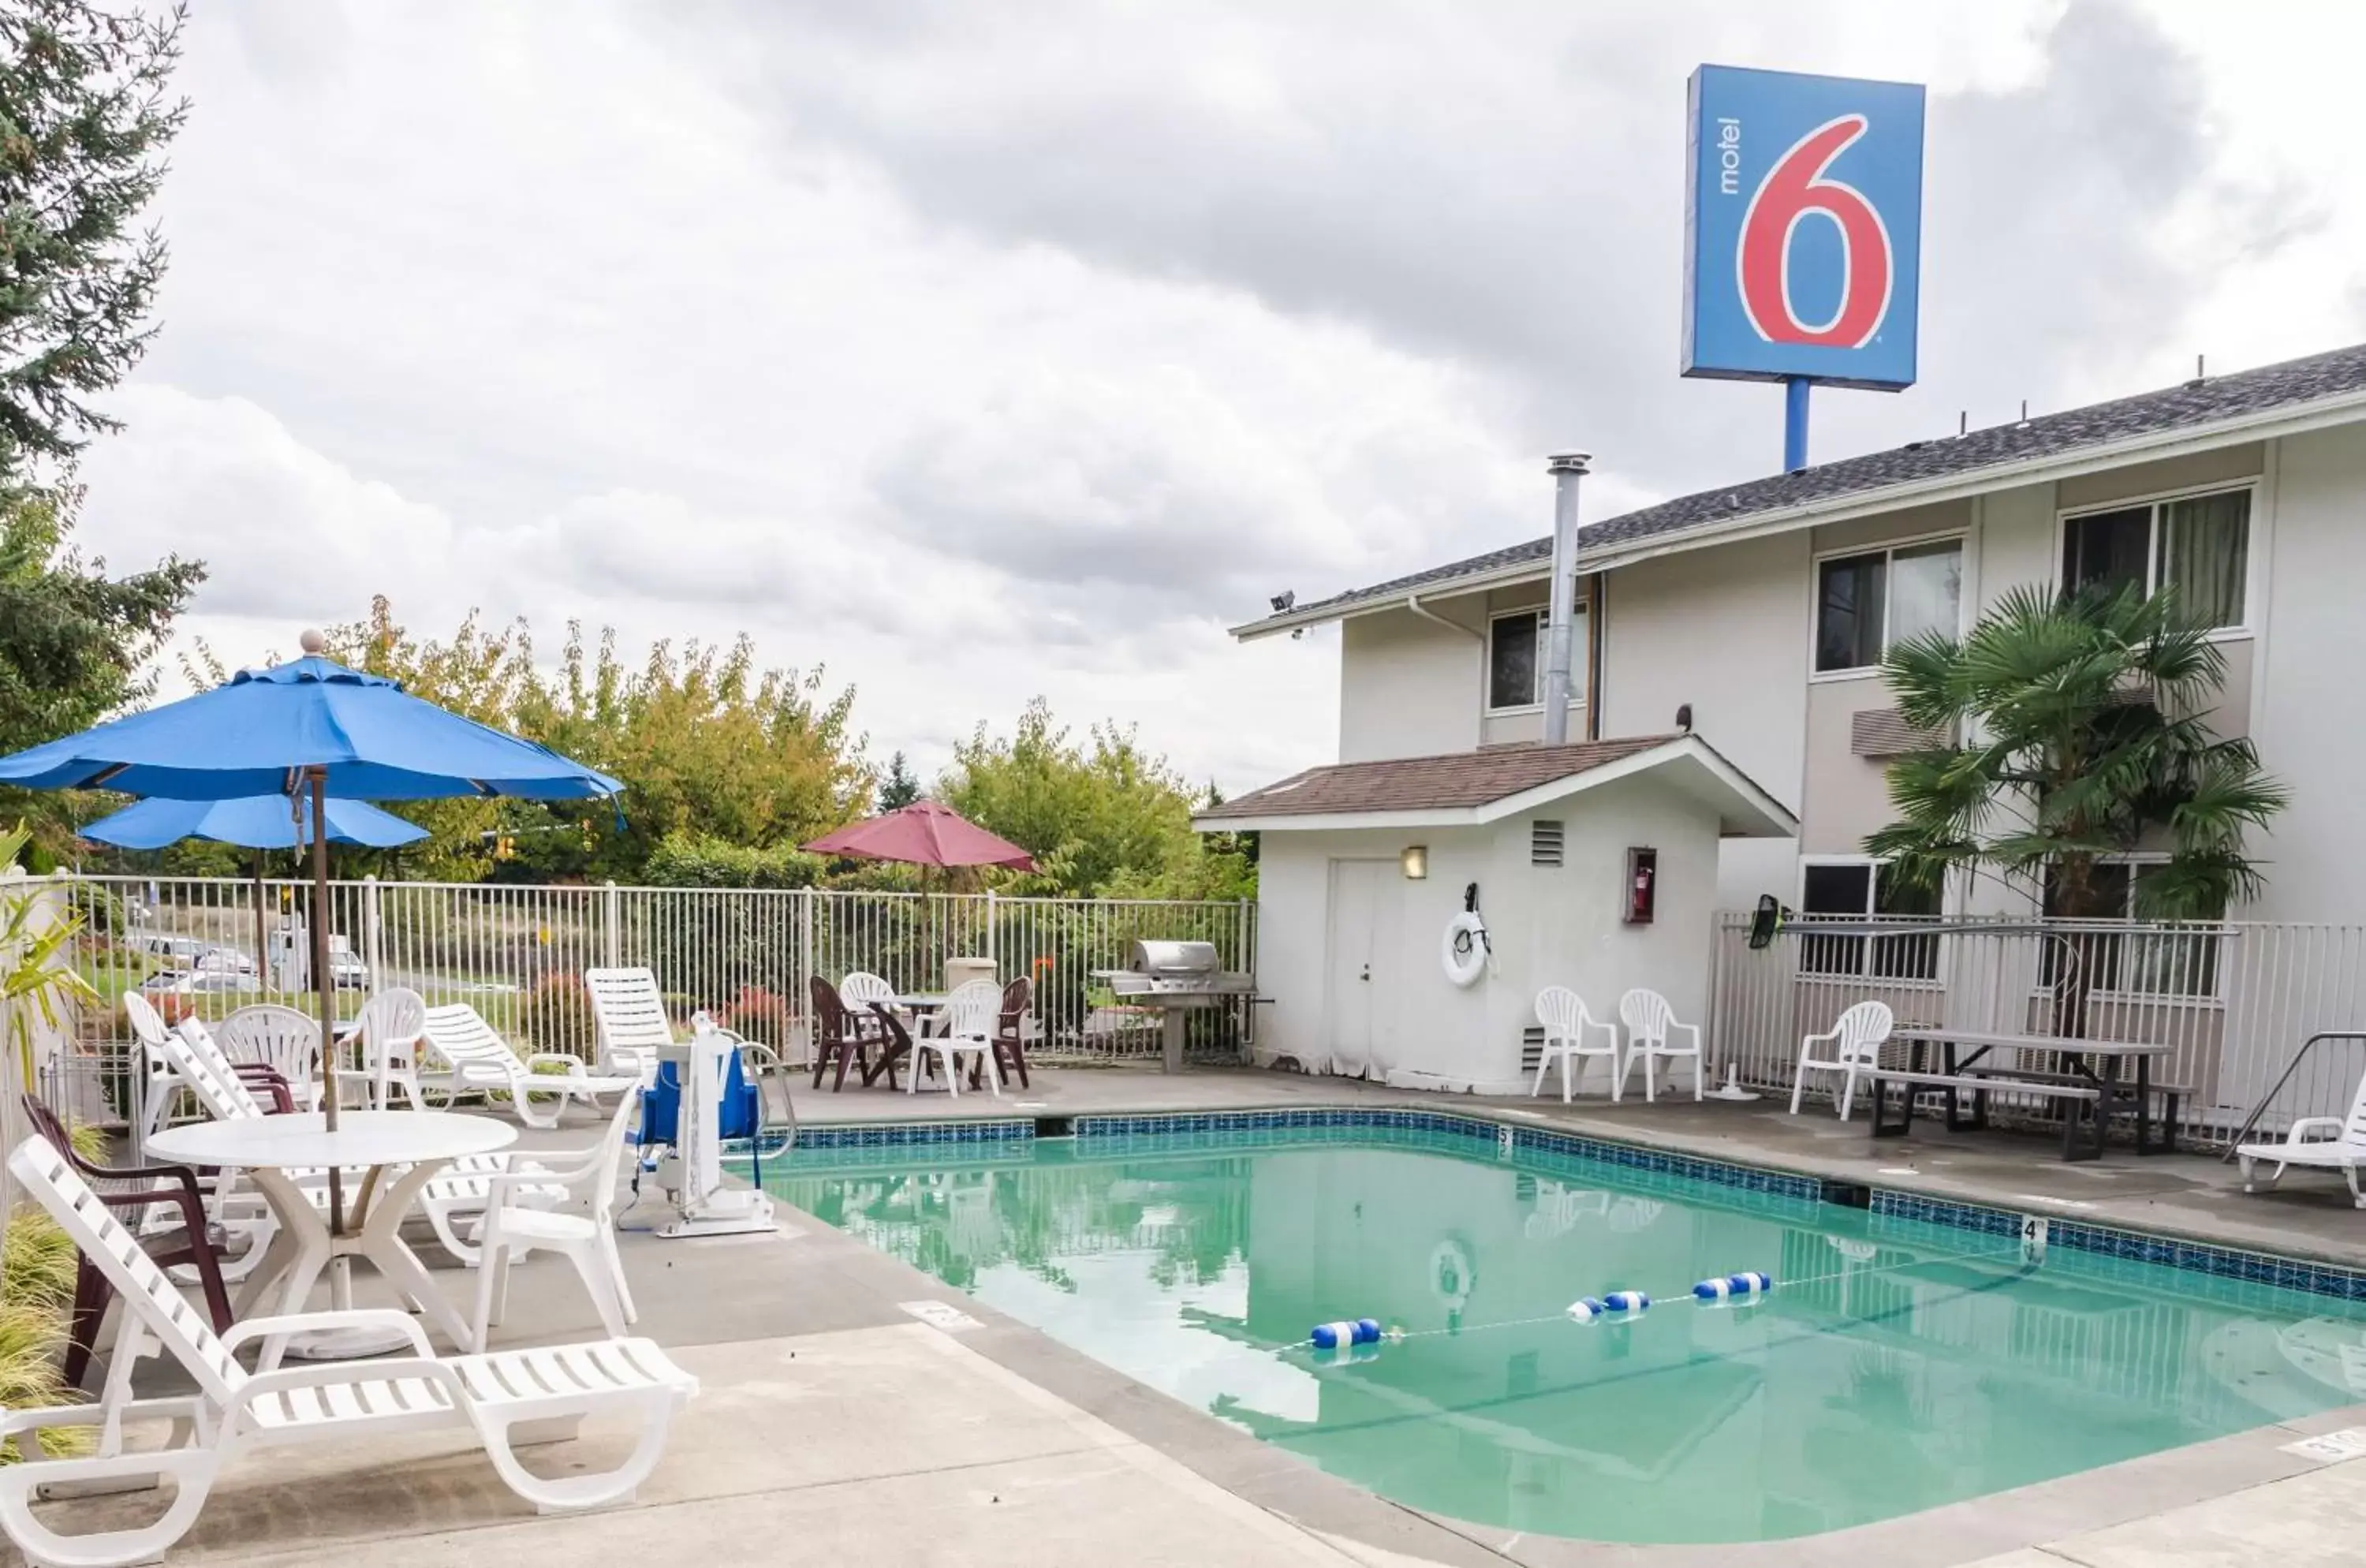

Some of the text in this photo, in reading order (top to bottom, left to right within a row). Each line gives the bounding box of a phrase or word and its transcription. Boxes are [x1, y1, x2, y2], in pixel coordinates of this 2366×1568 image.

[1717, 118, 1741, 194] motel
[1736, 113, 1894, 349] 6
[2025, 1220, 2036, 1239] 4
